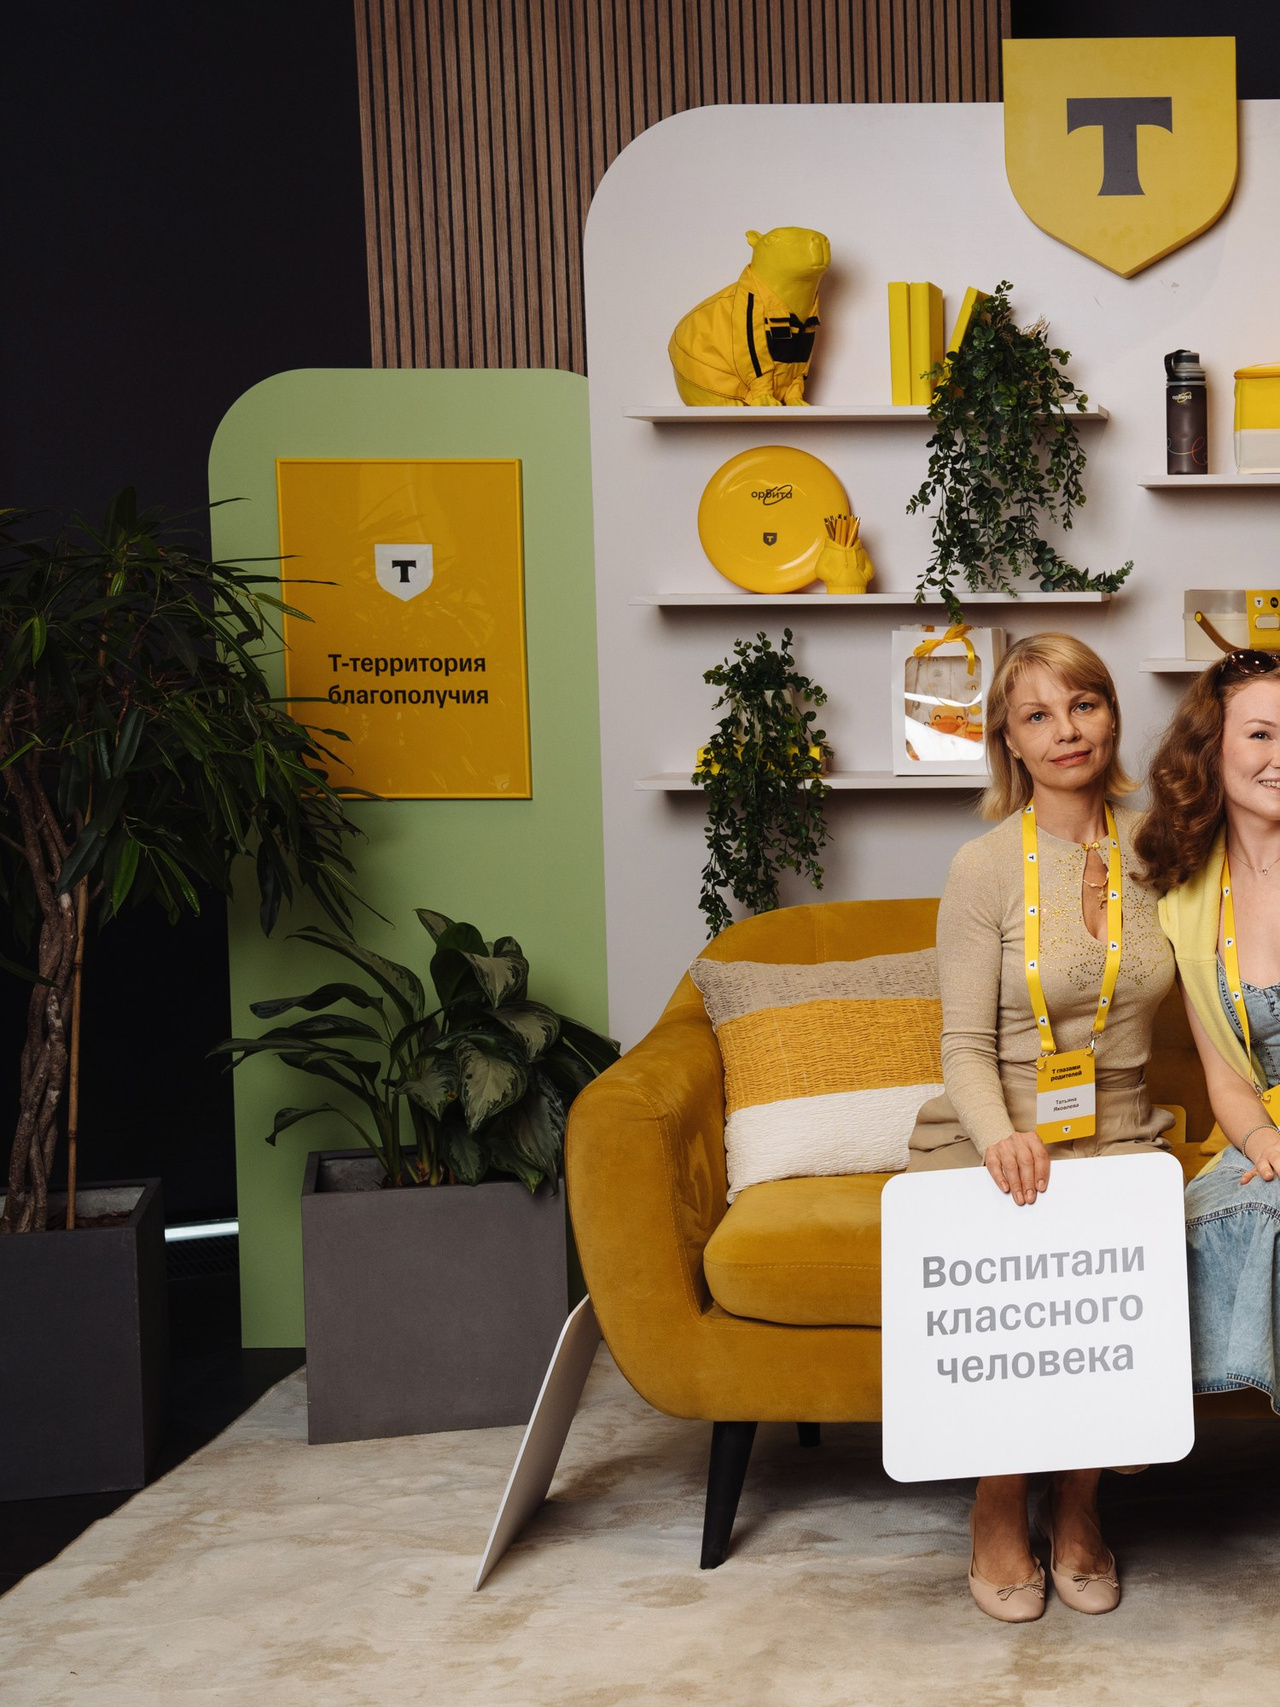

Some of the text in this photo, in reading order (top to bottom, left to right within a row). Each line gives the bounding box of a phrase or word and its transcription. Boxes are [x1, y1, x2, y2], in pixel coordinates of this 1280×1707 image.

[1066, 96, 1173, 196] Т
[391, 559, 417, 583] Т
[327, 653, 487, 677] Т-территория
[327, 684, 489, 709] благополучия
[1050, 1070, 1083, 1082] родителей
[1056, 1064, 1081, 1074] глазами
[1055, 1097, 1078, 1105] Татьяна
[922, 1245, 1145, 1289] Воспитали
[926, 1293, 1144, 1337] классного
[936, 1342, 1135, 1384] человека
